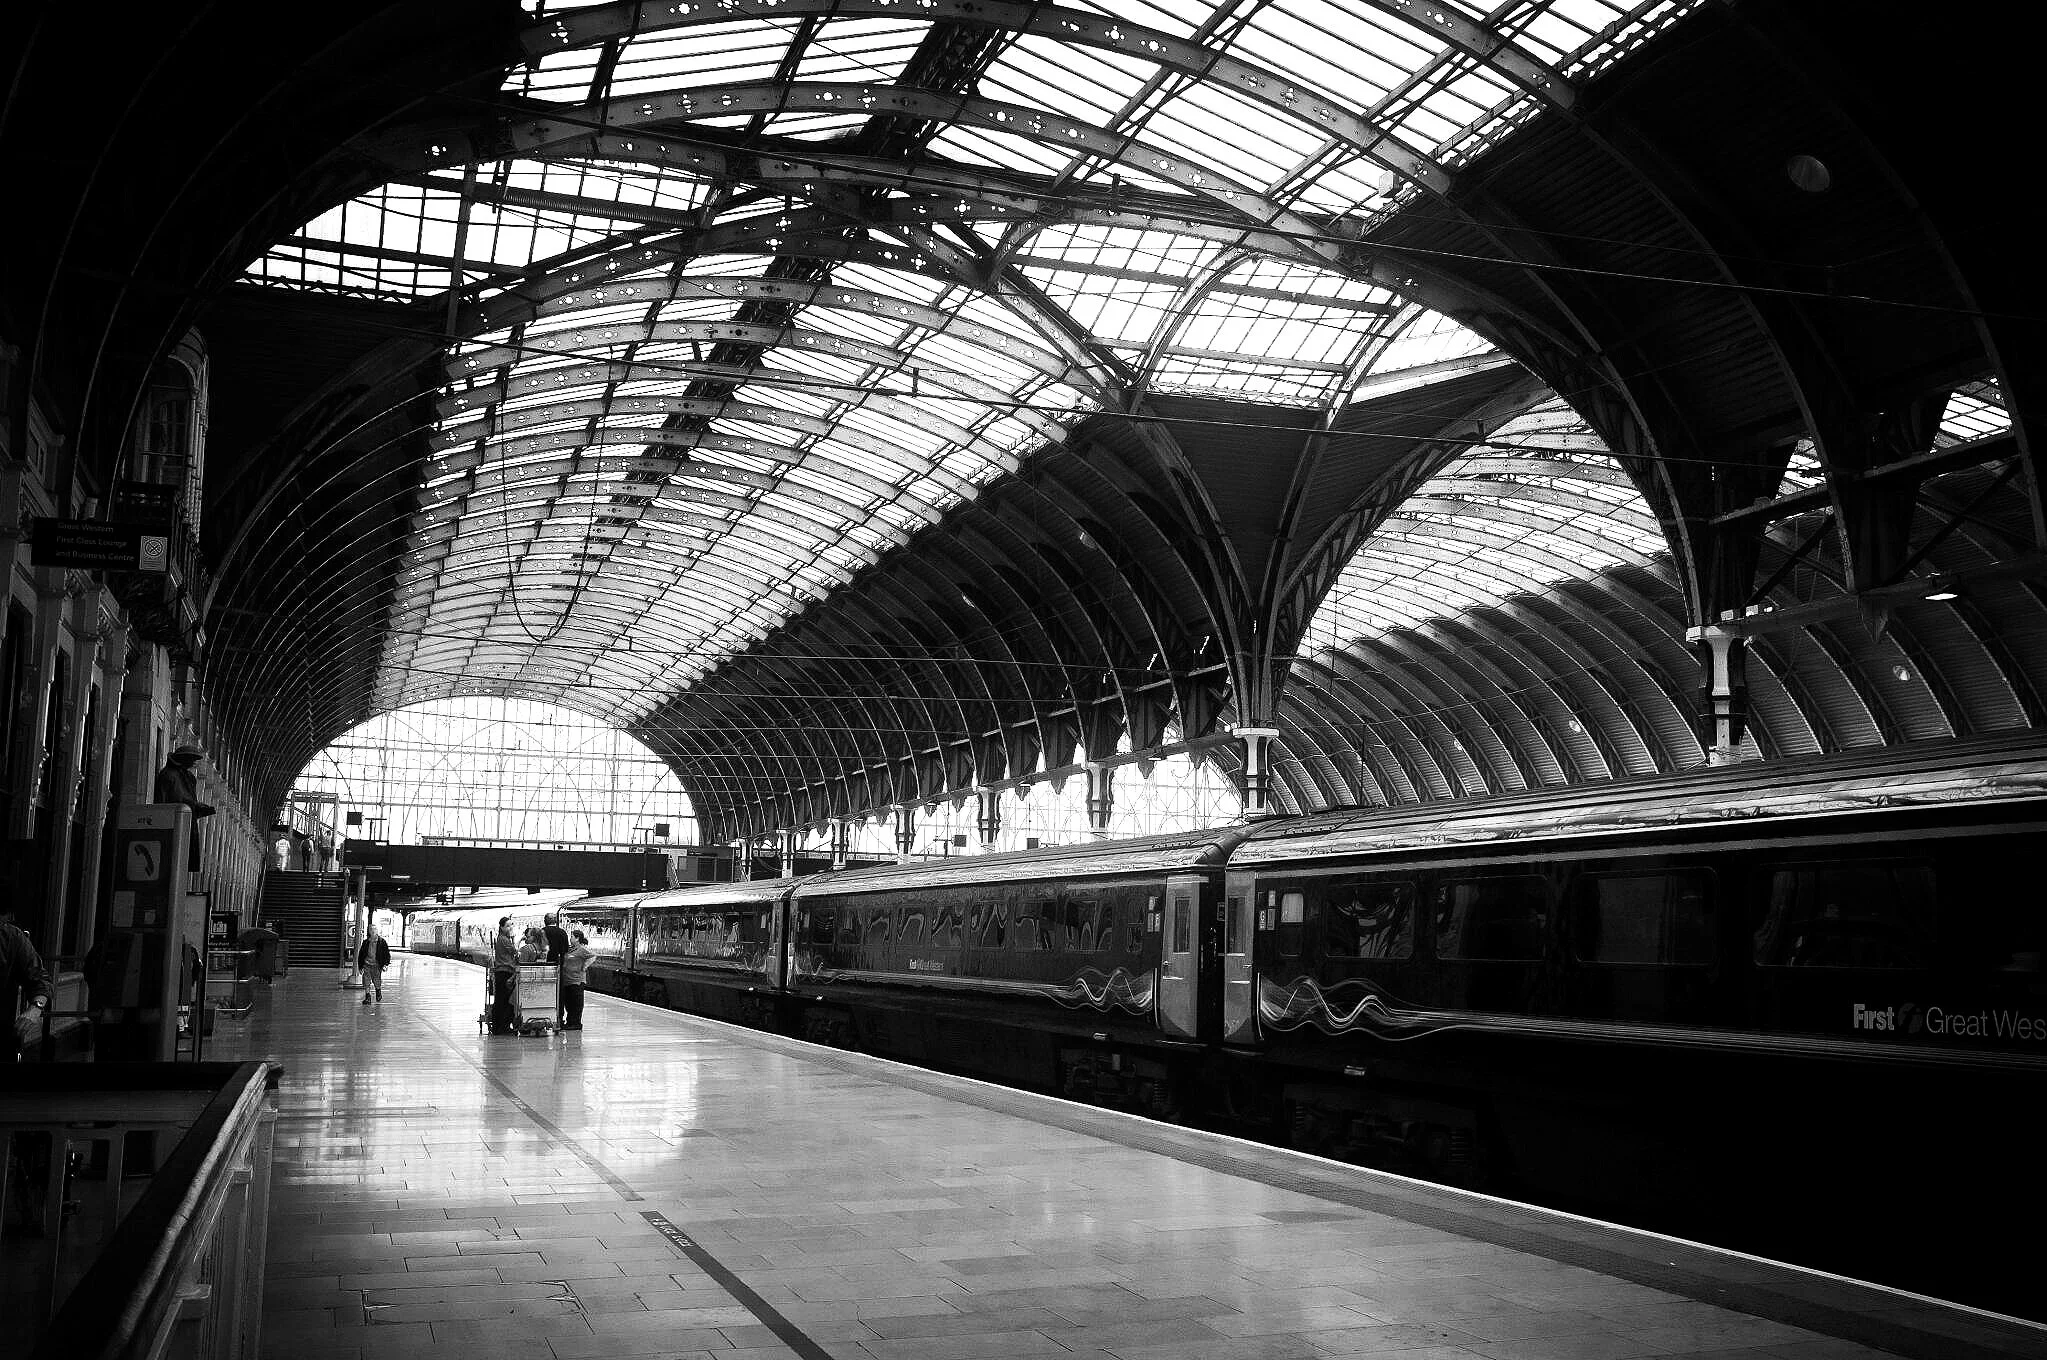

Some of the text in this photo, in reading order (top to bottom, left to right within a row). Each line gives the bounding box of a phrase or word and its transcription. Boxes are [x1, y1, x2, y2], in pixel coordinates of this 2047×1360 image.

[56, 535, 75, 544] First
[76, 536, 97, 546] Class
[72, 549, 107, 560] Business
[107, 552, 135, 562] Centre
[1853, 1003, 2047, 1041] First Great Wes
